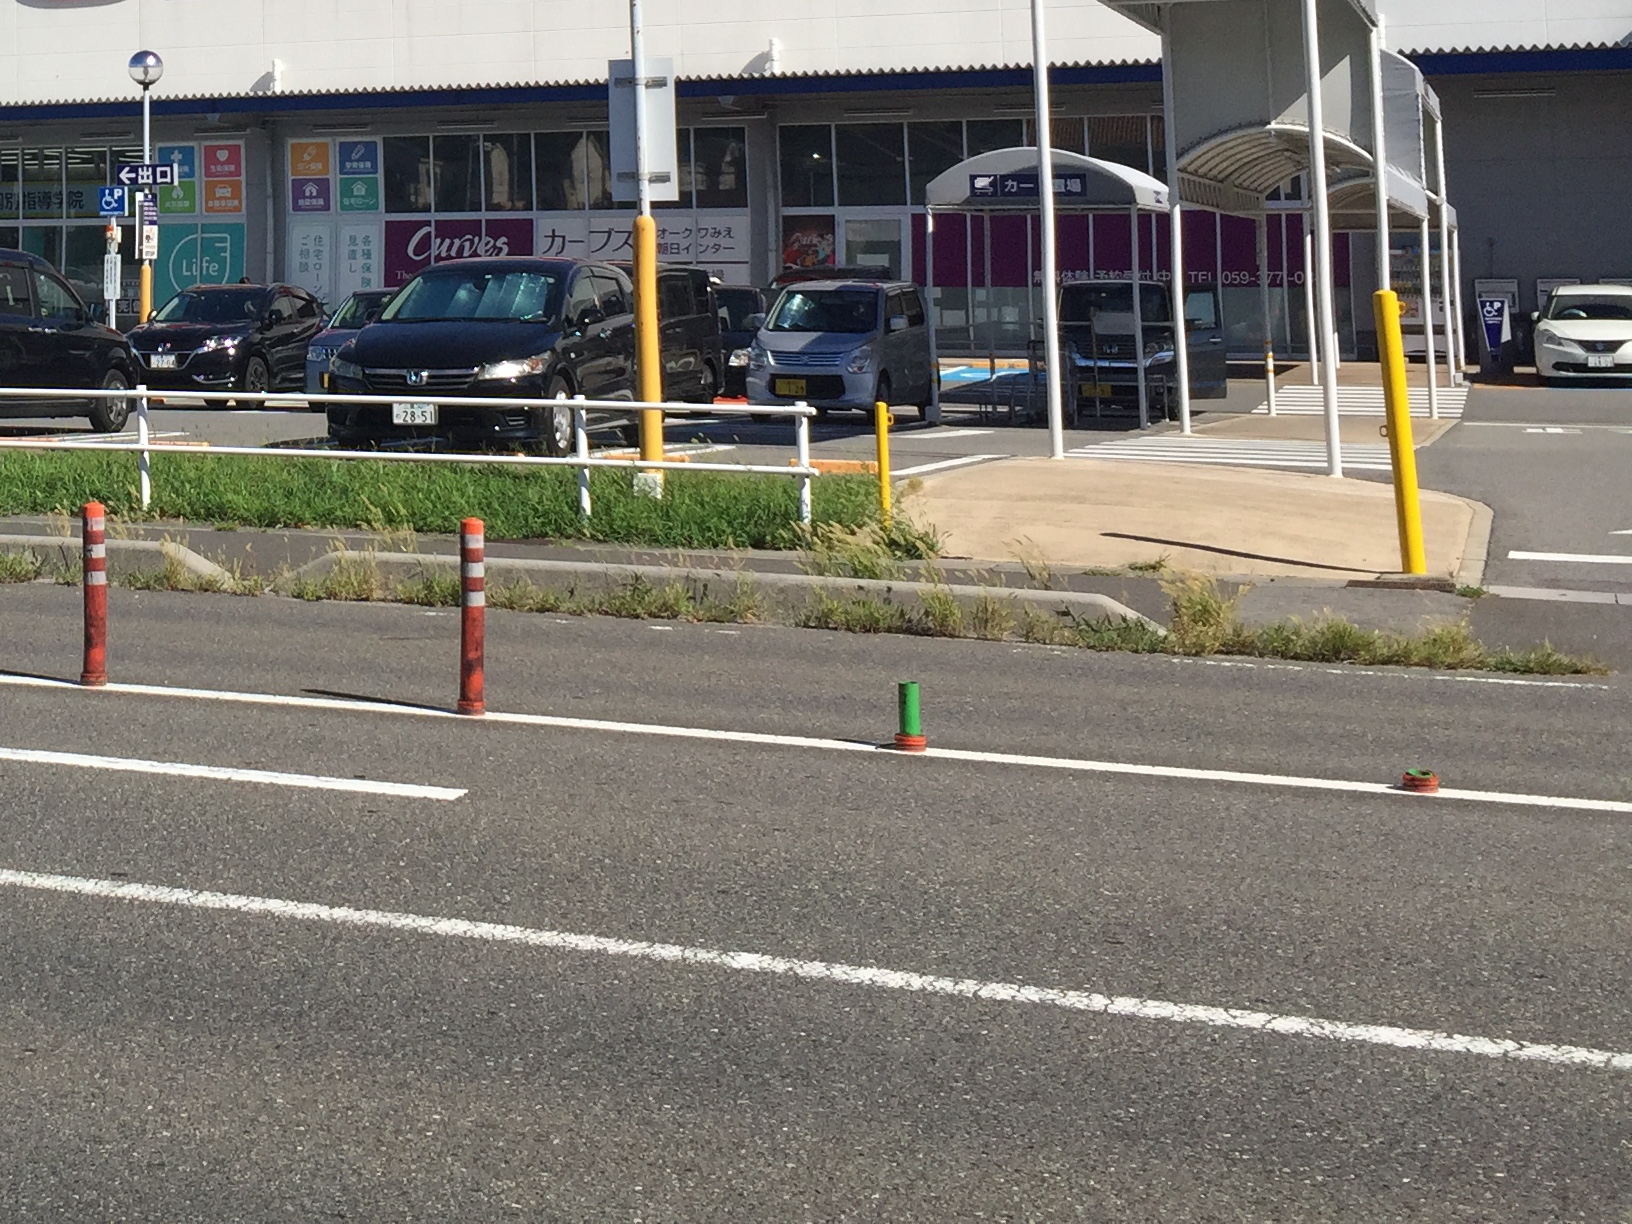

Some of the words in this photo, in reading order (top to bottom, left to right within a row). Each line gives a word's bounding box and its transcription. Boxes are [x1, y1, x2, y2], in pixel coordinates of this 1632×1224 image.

[137, 166, 172, 184] 出口
[1004, 178, 1082, 193] カー置場
[657, 227, 735, 239] オークワみえ
[407, 226, 509, 261] Curves
[542, 228, 633, 256] カーブス
[183, 257, 219, 275] Life
[1222, 271, 1305, 284] 059-77-0
[402, 410, 433, 423] 28-51
